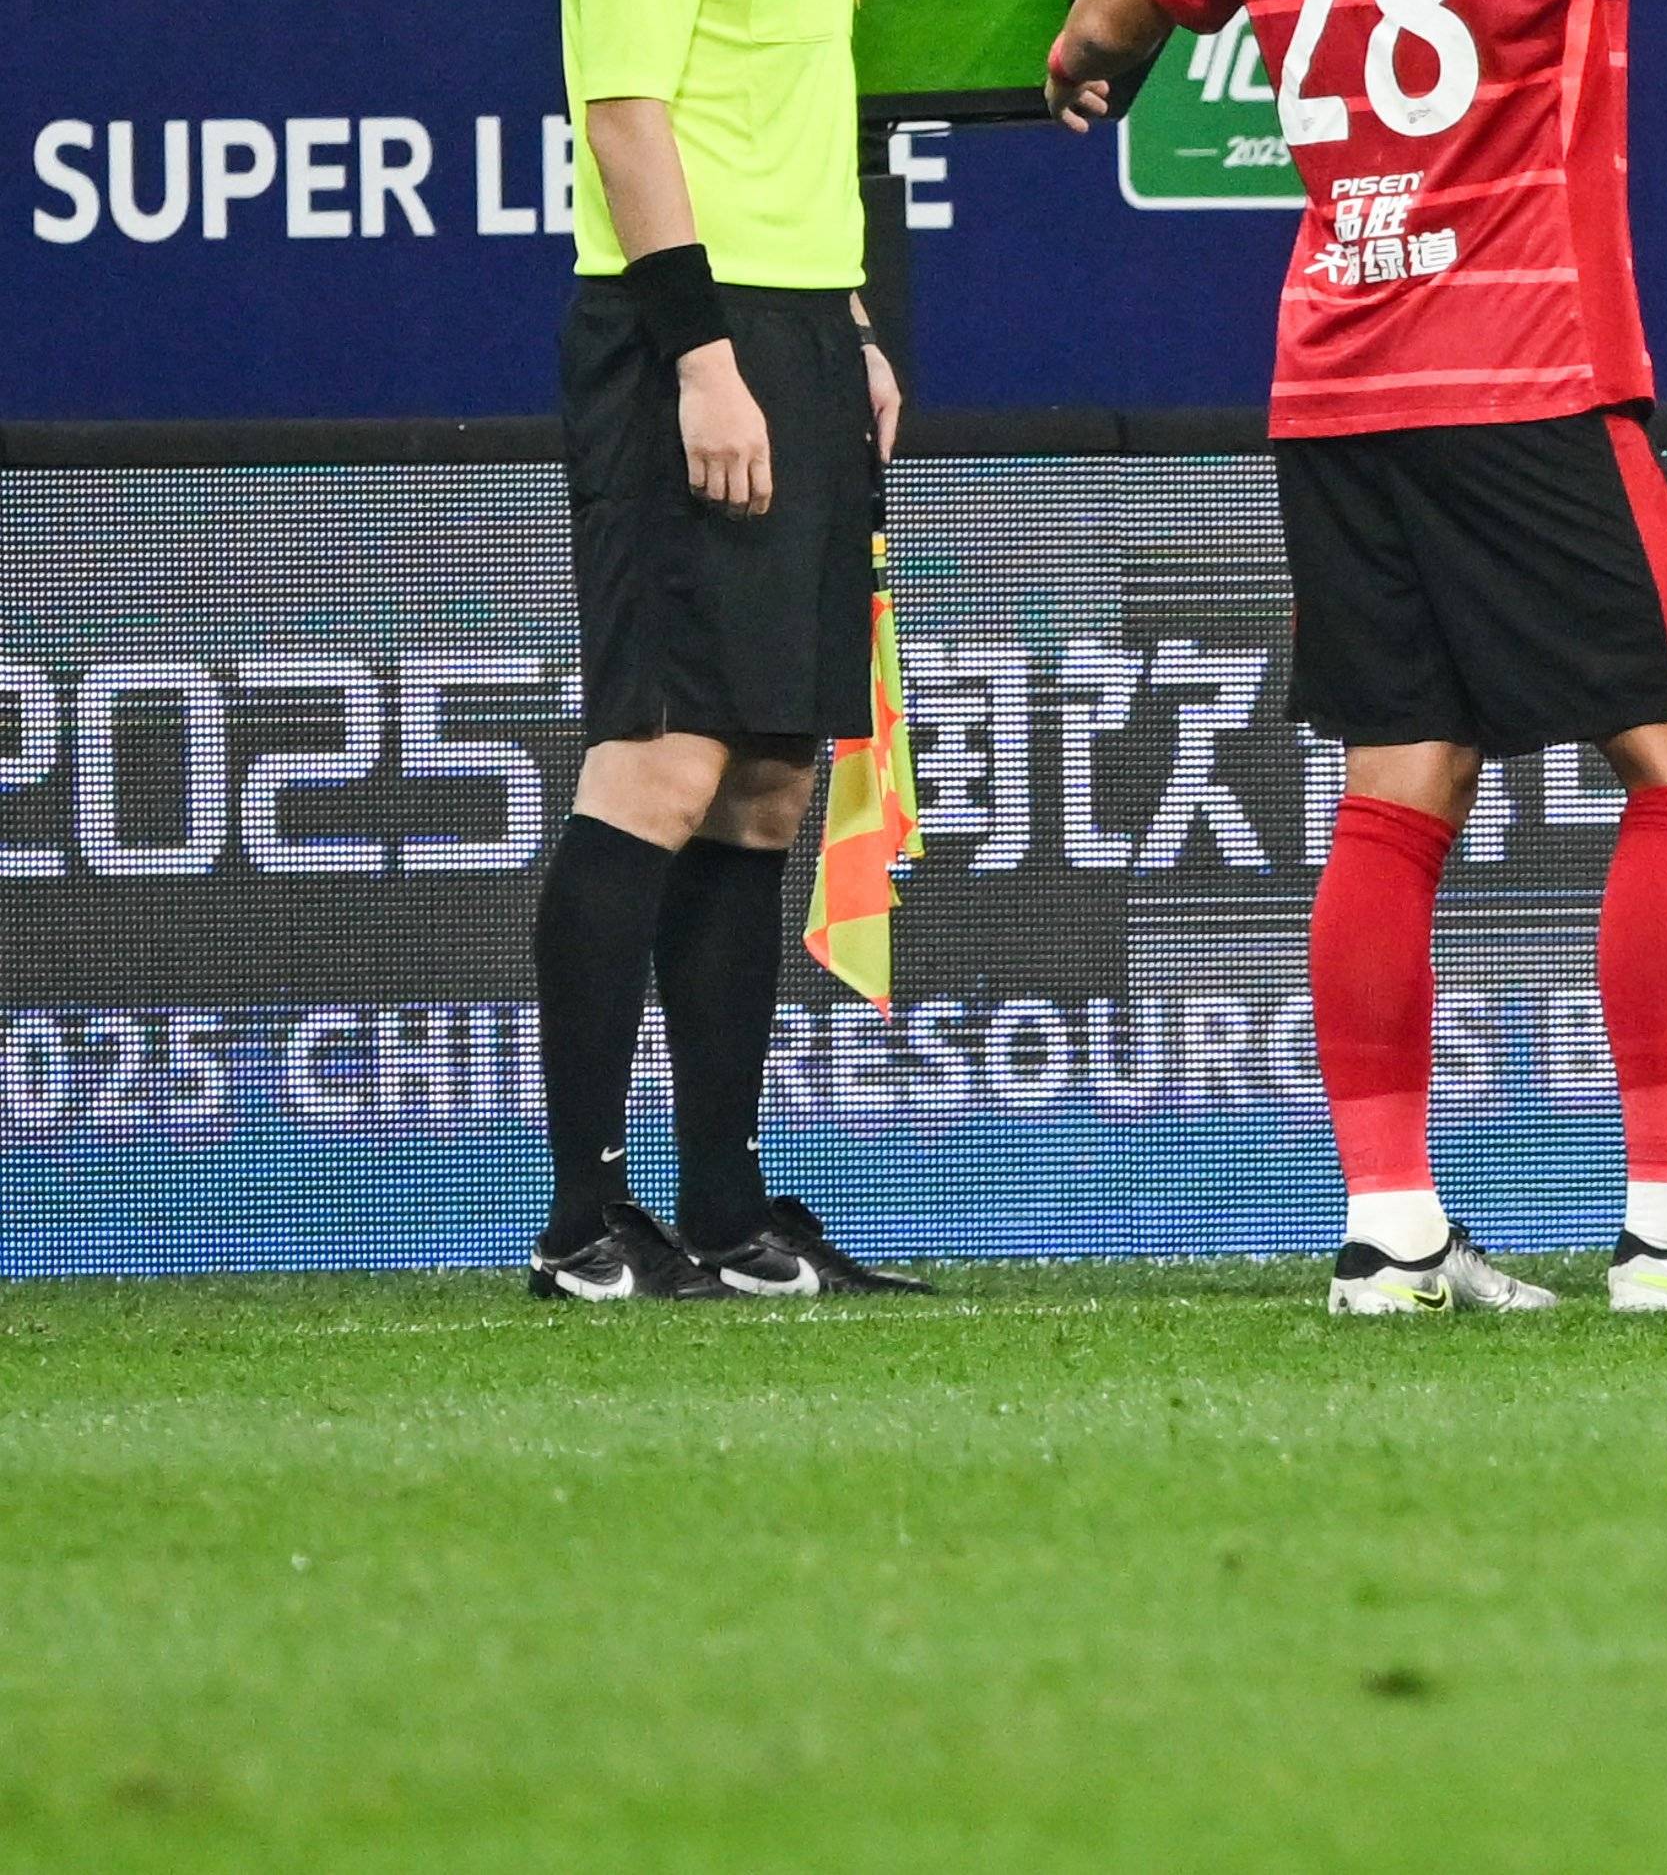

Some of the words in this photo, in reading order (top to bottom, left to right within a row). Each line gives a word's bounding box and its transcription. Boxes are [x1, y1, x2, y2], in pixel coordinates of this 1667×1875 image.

[33, 117, 435, 244] SUPER
[475, 115, 955, 238] LEE
[1330, 172, 1421, 200] PISEN
[1334, 193, 1414, 243] 品胜
